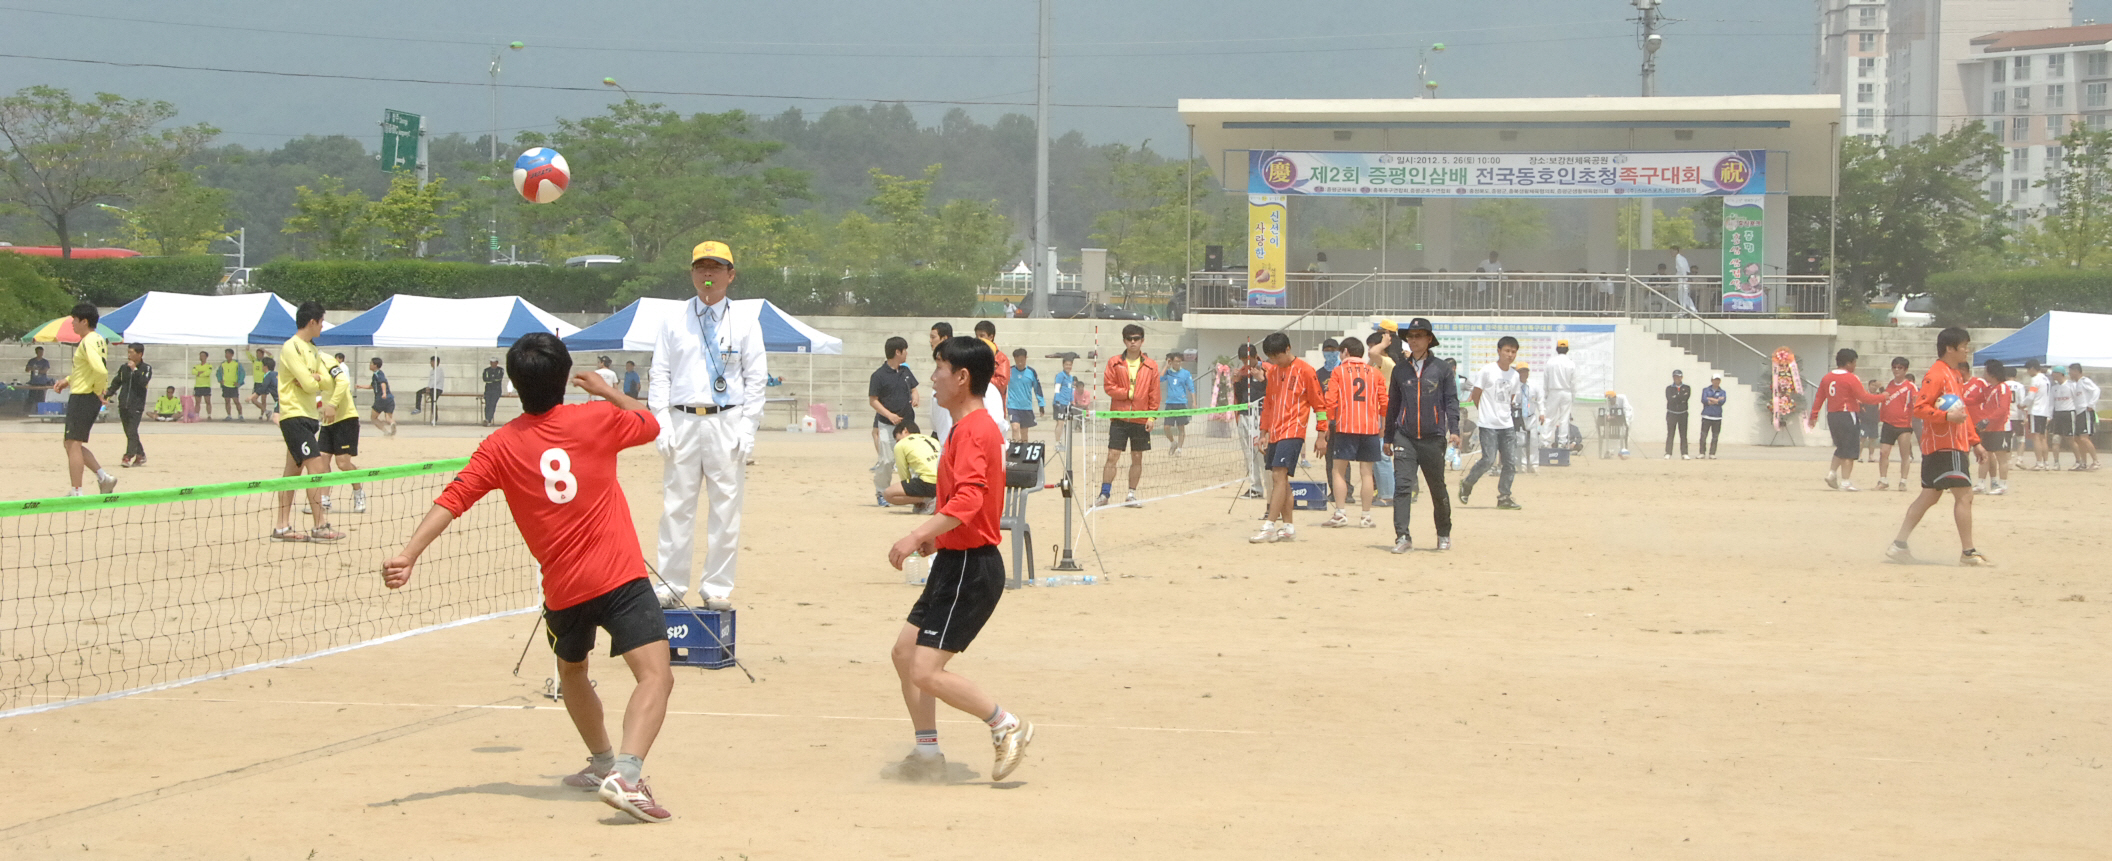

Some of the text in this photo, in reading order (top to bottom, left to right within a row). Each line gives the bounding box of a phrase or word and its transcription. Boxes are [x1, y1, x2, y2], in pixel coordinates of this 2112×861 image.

[1478, 156, 1501, 164] 10:00
[1269, 161, 1291, 183] 慶
[1310, 166, 1359, 184] 제2회
[1368, 166, 1467, 185] 증평인삼배
[1720, 162, 1744, 184] 祝
[1269, 210, 1280, 248] 신선이
[1254, 222, 1266, 260] 사랑한
[1353, 377, 1366, 402] 2
[1828, 381, 1837, 397] 6
[301, 441, 311, 456] 6
[1014, 445, 1041, 460] 1 15
[540, 447, 578, 504] 8
[22, 501, 41, 510] star
[103, 495, 120, 503] star
[667, 624, 689, 640] Cas
